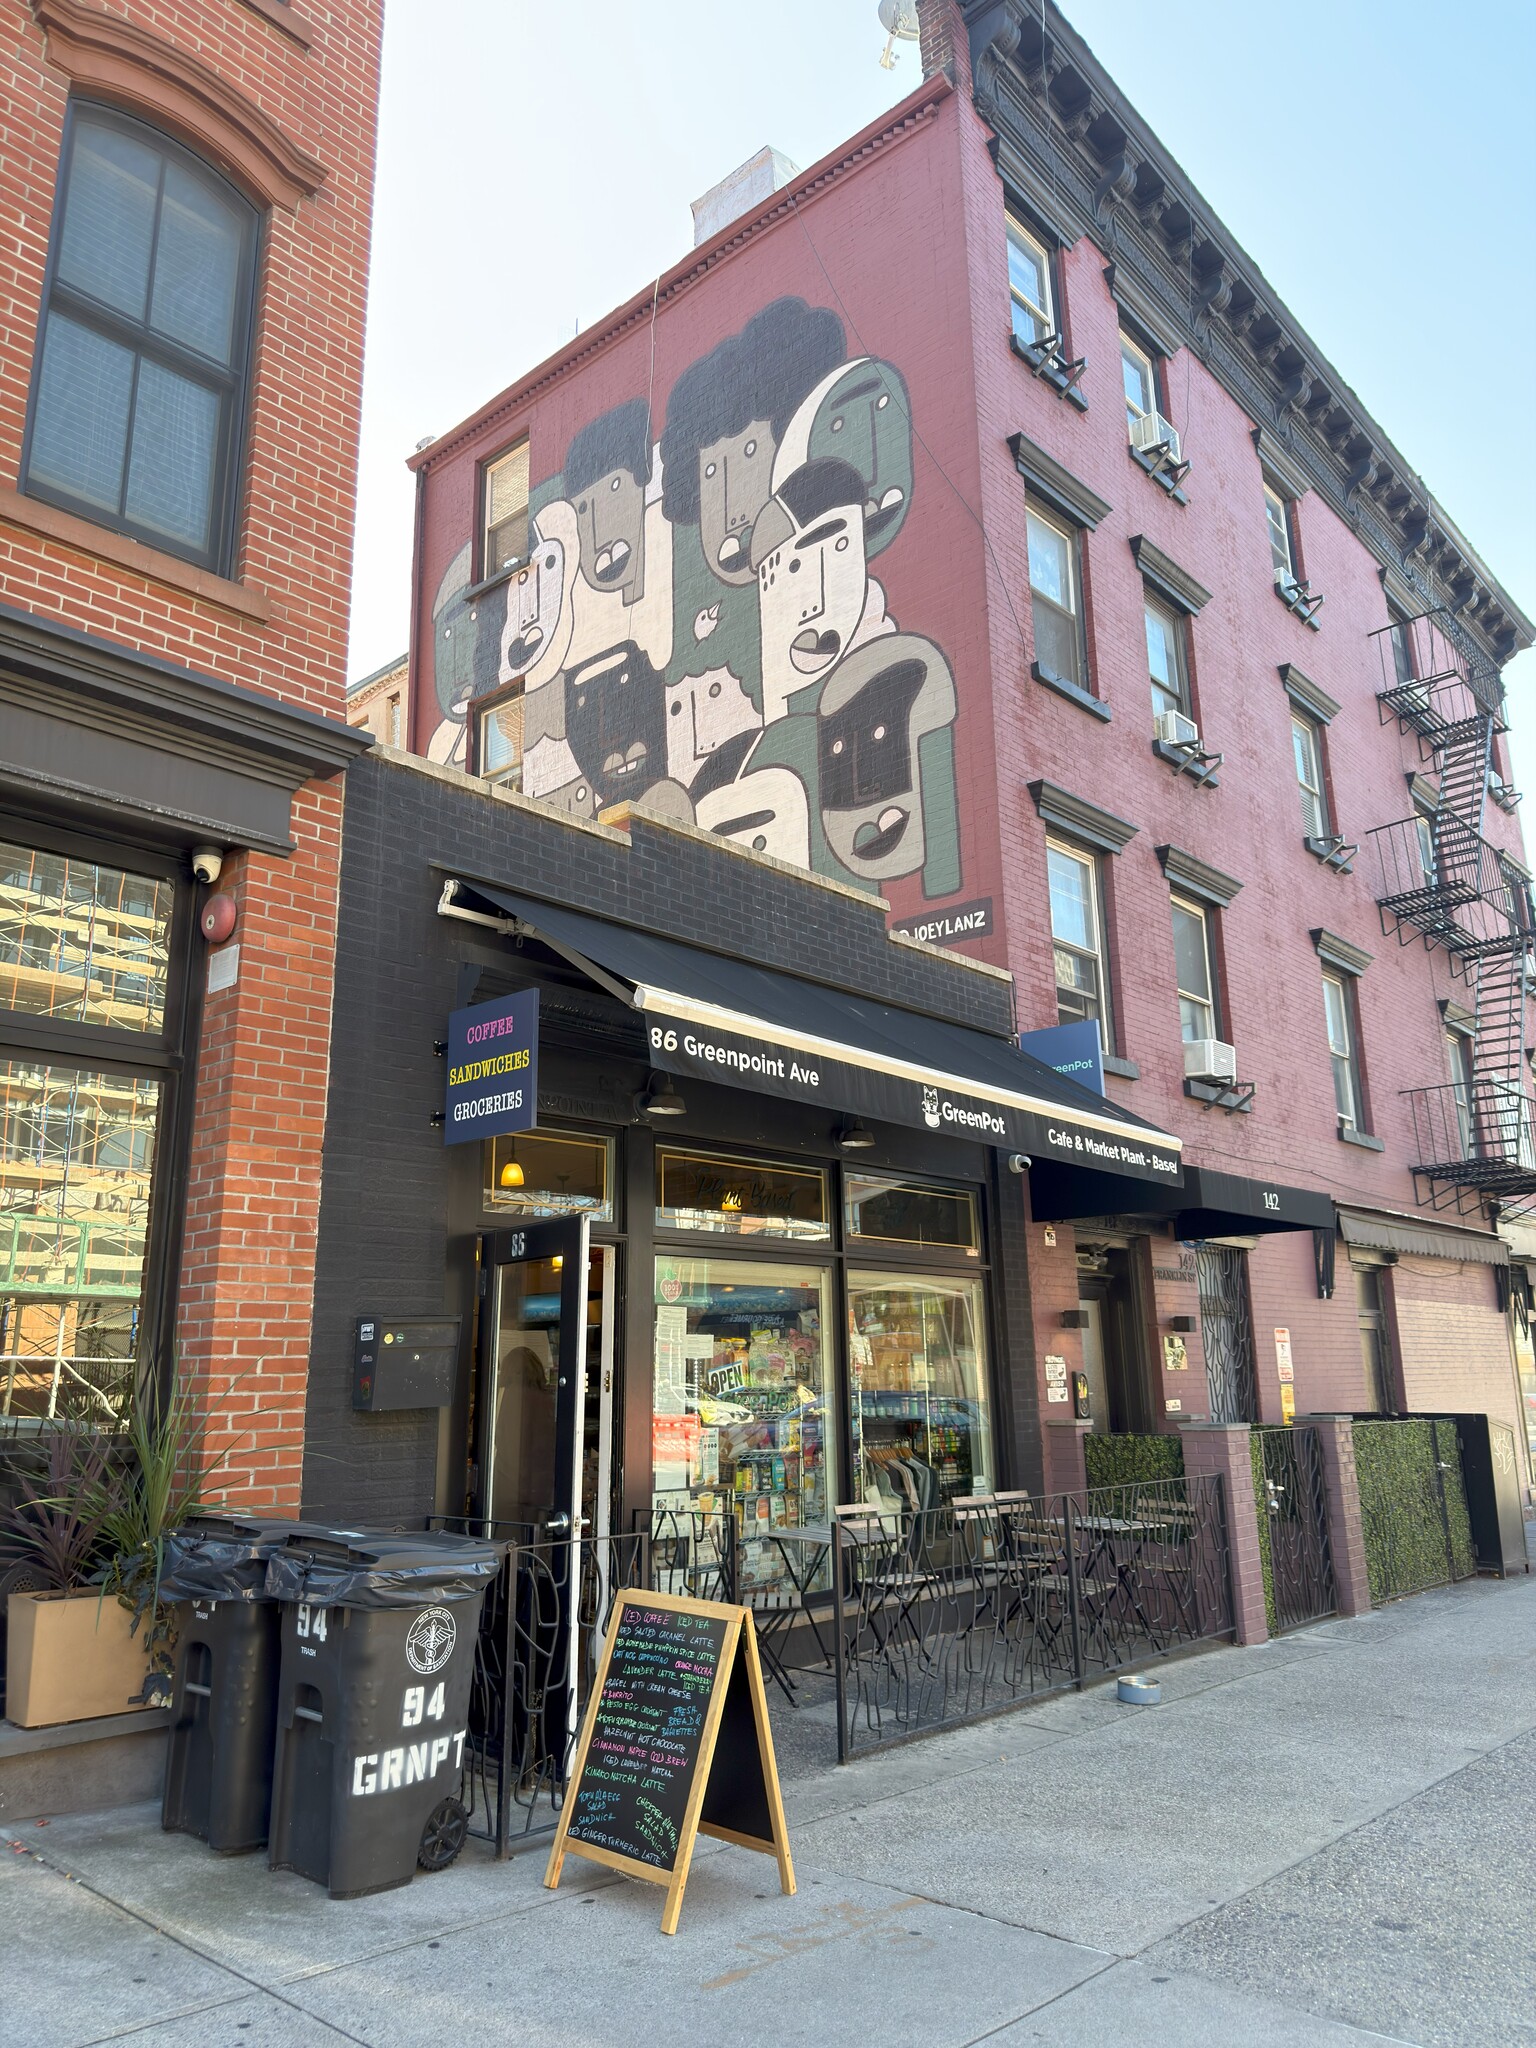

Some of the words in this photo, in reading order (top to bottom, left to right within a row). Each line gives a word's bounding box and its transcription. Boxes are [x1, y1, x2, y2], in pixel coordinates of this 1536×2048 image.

[466, 1015, 514, 1045] COFFEE
[449, 1049, 530, 1086] SANDWICHES
[650, 1027, 678, 1052] 86
[683, 1035, 785, 1077] Greenpoint
[789, 1062, 820, 1086] Ave
[1052, 1059, 1094, 1073] reenPot
[453, 1089, 523, 1122] GROCERIES
[942, 1101, 1006, 1135] GreenPot
[1048, 1128, 1073, 1149] Cafe
[1075, 1137, 1084, 1151] &
[1085, 1137, 1120, 1160] Market
[1121, 1147, 1146, 1167] Plant
[1262, 1191, 1281, 1211] 142
[511, 1231, 525, 1257] 86
[1178, 1252, 1196, 1271] 142
[1153, 1268, 1187, 1282] FRANKLIN
[1187, 1271, 1197, 1283] ST
[710, 1364, 745, 1397] OPEN
[297, 1603, 328, 1642] 94
[418, 1613, 429, 1624] NEW
[441, 1611, 451, 1621] CITY
[624, 1608, 642, 1625] ICED
[643, 1612, 673, 1625] COFFEE
[677, 1615, 693, 1628] ICED
[694, 1619, 713, 1630] TEA
[619, 1626, 632, 1636] ICED
[634, 1626, 656, 1639] SALTED
[658, 1630, 686, 1642] CARAMEL
[690, 1636, 717, 1650] LATTE
[301, 1646, 317, 1657] TRASH
[408, 1646, 428, 1671] DEPARTMENT
[432, 1641, 453, 1670] SANITATION
[613, 1649, 626, 1660] OAT
[625, 1651, 637, 1661] NOG
[654, 1643, 679, 1655] PUMPKIN
[679, 1648, 696, 1660] SPICE
[696, 1652, 717, 1663] LATTE
[622, 1664, 655, 1676] LAVENDER
[657, 1669, 678, 1681] LATTE
[692, 1664, 714, 1677] MOCHA
[605, 1678, 627, 1689] BAGEL
[631, 1680, 646, 1690] WITH
[647, 1683, 667, 1695] CREAM
[667, 1687, 692, 1700] CHEESE
[608, 1690, 634, 1700] BURRITO
[683, 1680, 696, 1691] ICED
[698, 1685, 711, 1695] TEA
[401, 1682, 446, 1727] 94
[606, 1699, 624, 1709] PESTO
[624, 1703, 640, 1711] EGG
[673, 1705, 698, 1717] FRESH
[668, 1716, 694, 1727] BREAD
[694, 1713, 702, 1727] &
[592, 1736, 625, 1753] CINNAMON
[628, 1746, 648, 1758] MAPLE
[650, 1751, 665, 1763] COLD
[665, 1755, 689, 1767] BREW
[603, 1726, 636, 1741] HAZELNUT
[637, 1733, 653, 1745] HOT
[651, 1738, 687, 1755] CHOCOLATE
[352, 1730, 467, 1796] GRNPT
[603, 1754, 619, 1767] ICED
[620, 1758, 648, 1770] LAVENDER
[651, 1765, 674, 1778] MATCHA
[584, 1765, 610, 1780] KINAKO
[610, 1771, 638, 1785] MATCHA
[640, 1777, 667, 1794] LATTE
[608, 1792, 621, 1802] EGG
[578, 1813, 616, 1825] SANDWICH
[643, 1813, 664, 1836] SALAD
[581, 1827, 607, 1844] GINGER
[607, 1836, 639, 1856] TURMERIC
[641, 1849, 663, 1868] LATTE
[635, 1820, 669, 1859] SANDWICH
